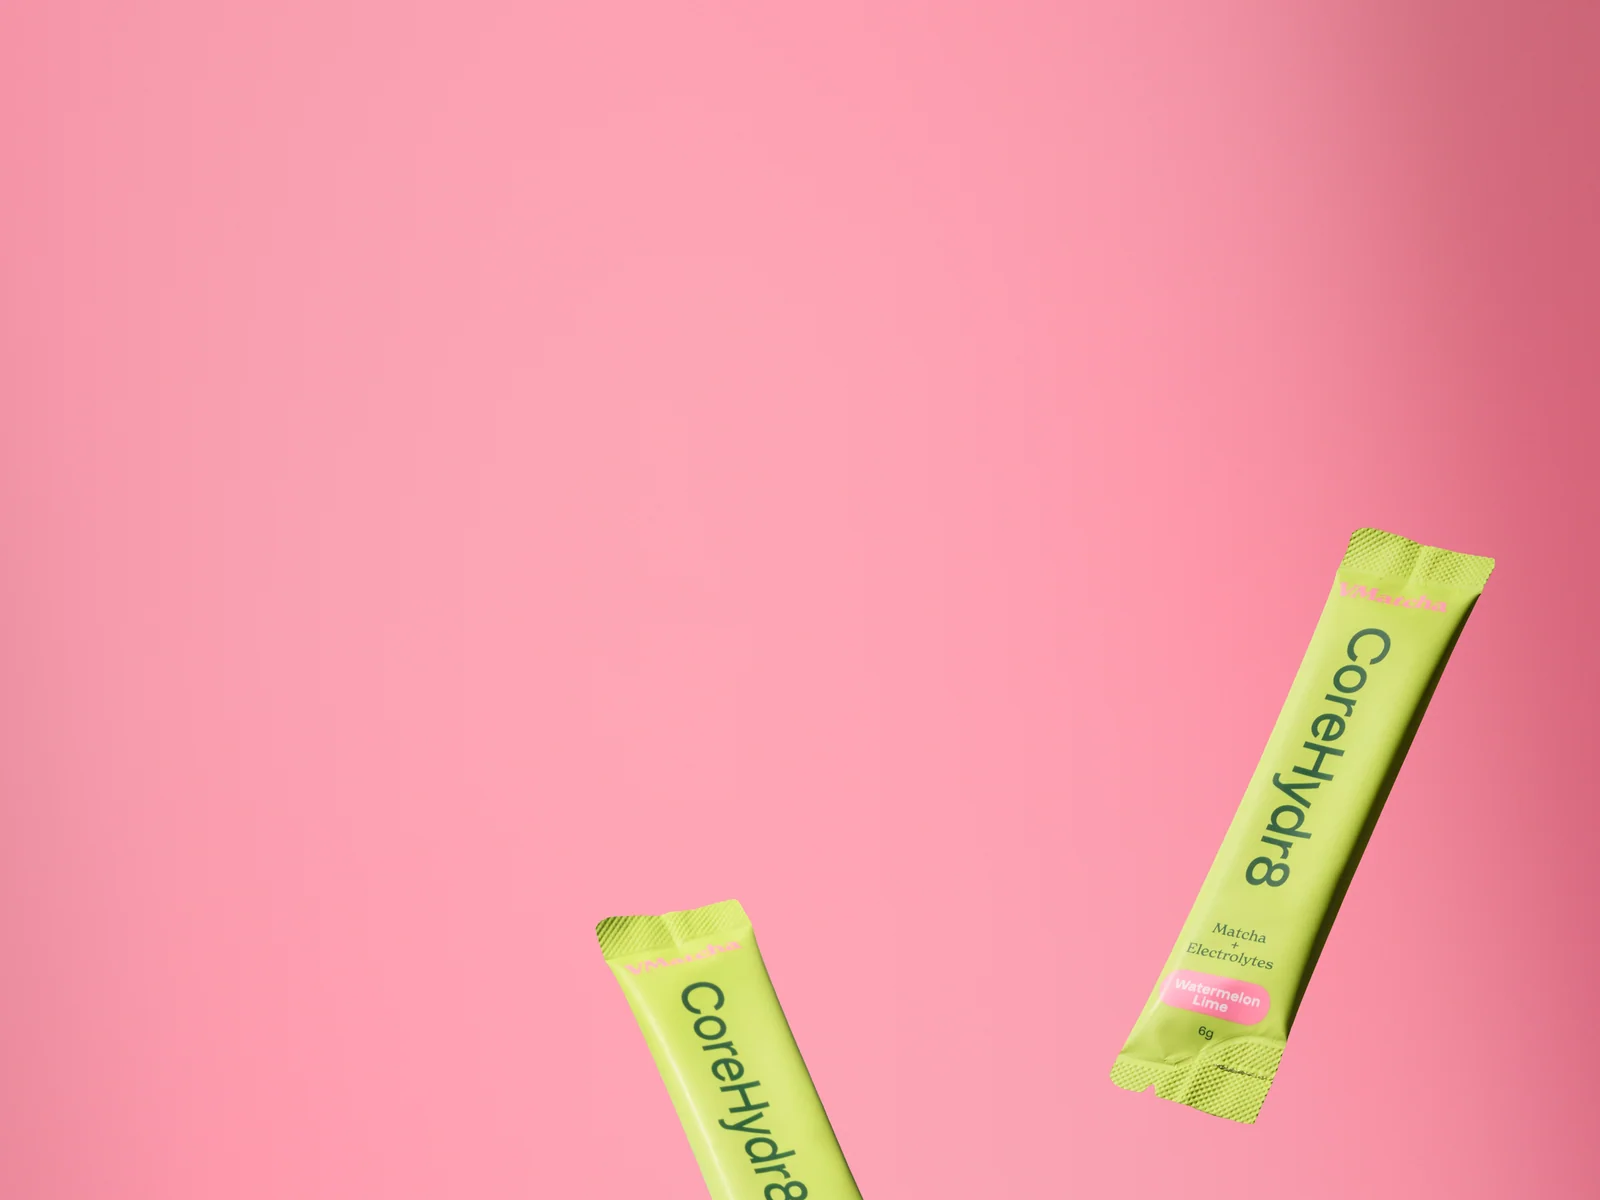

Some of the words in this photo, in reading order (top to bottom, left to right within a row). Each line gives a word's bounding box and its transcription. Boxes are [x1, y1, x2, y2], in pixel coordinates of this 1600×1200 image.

[1245, 628, 1391, 887] CoreHydr8
[1212, 922, 1267, 944] Matcha
[1186, 942, 1274, 971] Electrolytes
[1175, 978, 1261, 1008] Watermelon
[1192, 994, 1229, 1013] Lime
[1198, 1026, 1214, 1041] 6g
